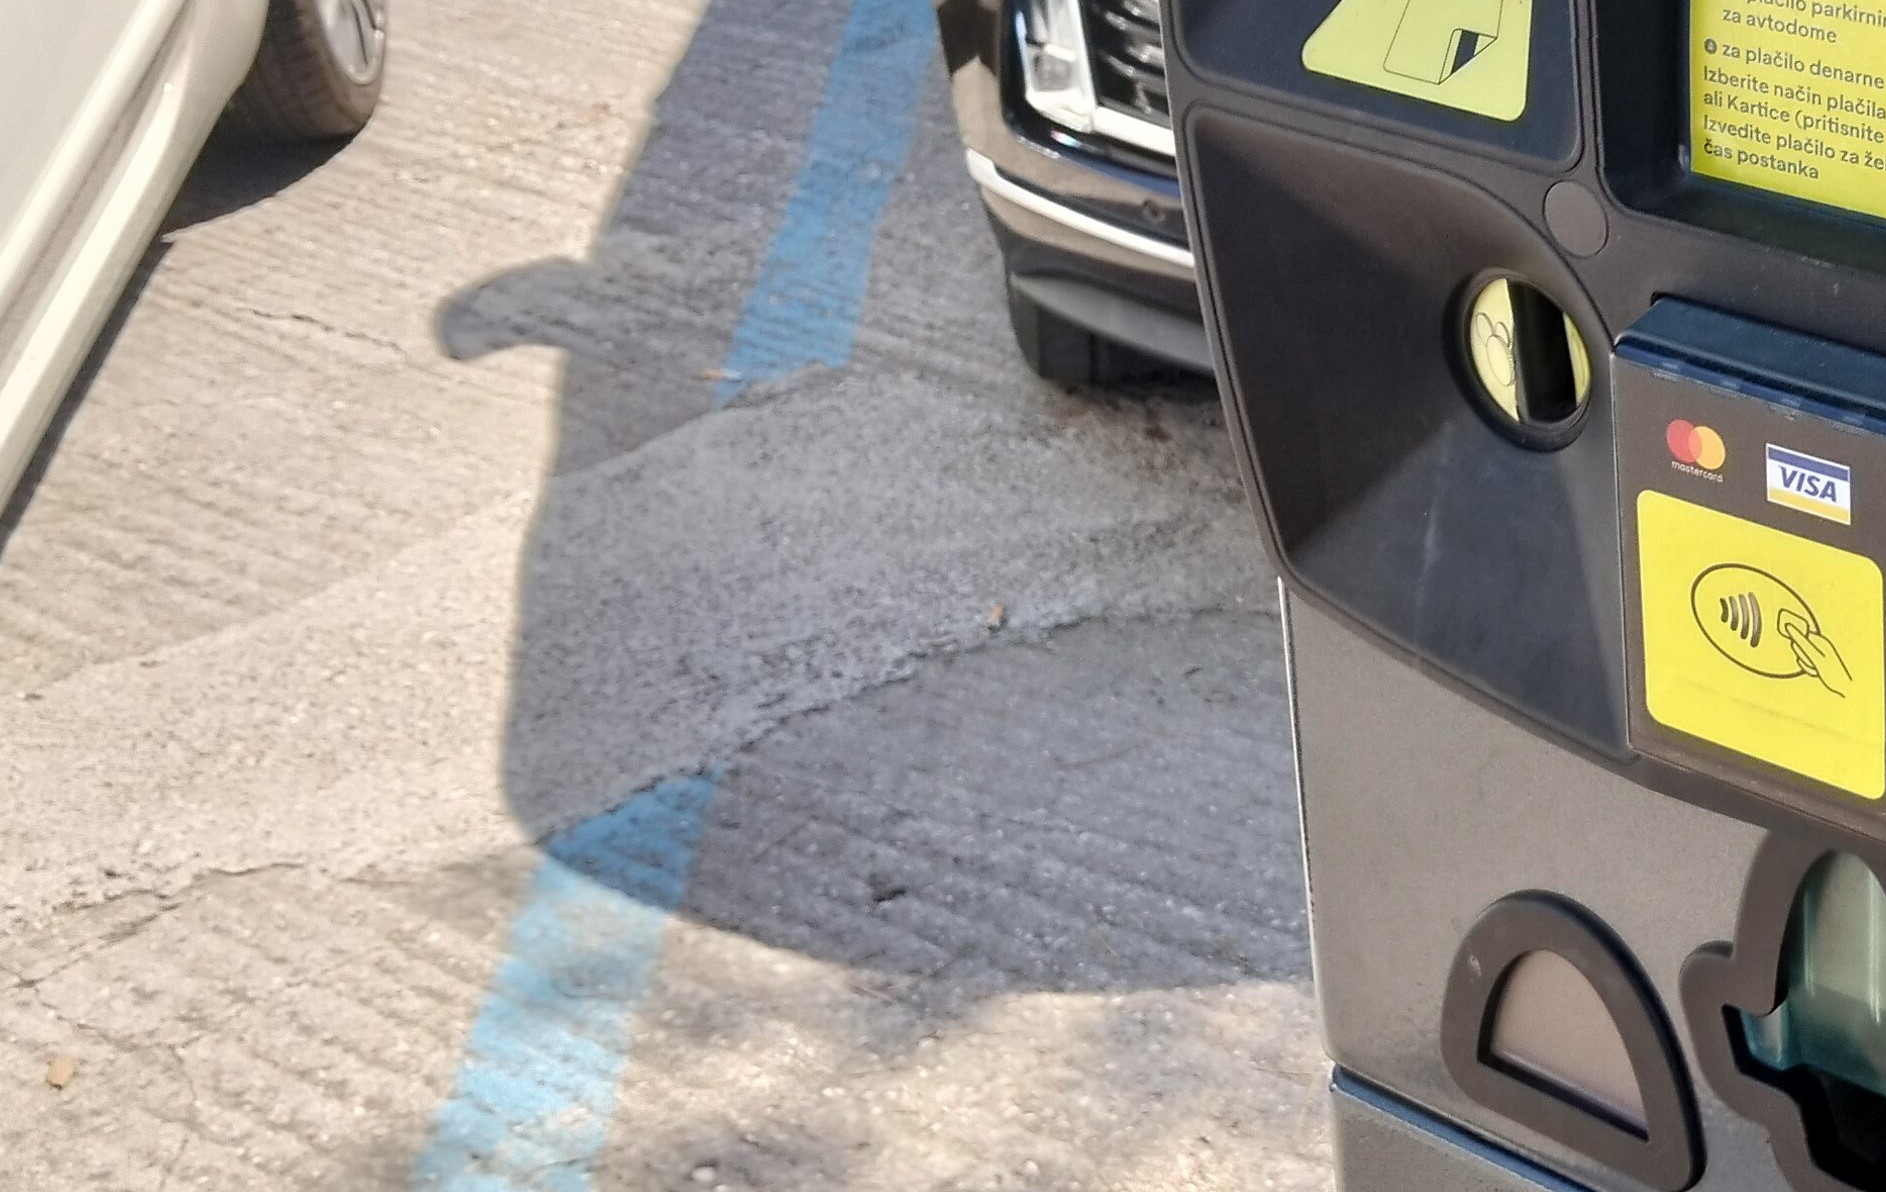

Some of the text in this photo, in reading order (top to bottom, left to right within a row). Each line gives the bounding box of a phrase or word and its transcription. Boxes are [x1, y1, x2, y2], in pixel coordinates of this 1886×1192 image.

[1723, 9, 1837, 43] za avtodome
[1722, 44, 1740, 58] za
[1746, 47, 1805, 72] plačilo
[1809, 60, 1884, 89] denarne
[1704, 65, 1769, 94] Izberite
[1774, 84, 1821, 105] način
[1827, 94, 1886, 120] plačila
[1704, 90, 1722, 107] ali
[1727, 94, 1790, 123] Kartice
[1795, 110, 1884, 144] (pritisnite
[1703, 114, 1771, 144] Izvedite
[1776, 133, 1835, 159] plačilo
[1840, 150, 1859, 165] za
[1703, 137, 1819, 179] čas postanka
[1672, 460, 1723, 483] mastercard
[1779, 465, 1837, 503] VISA
